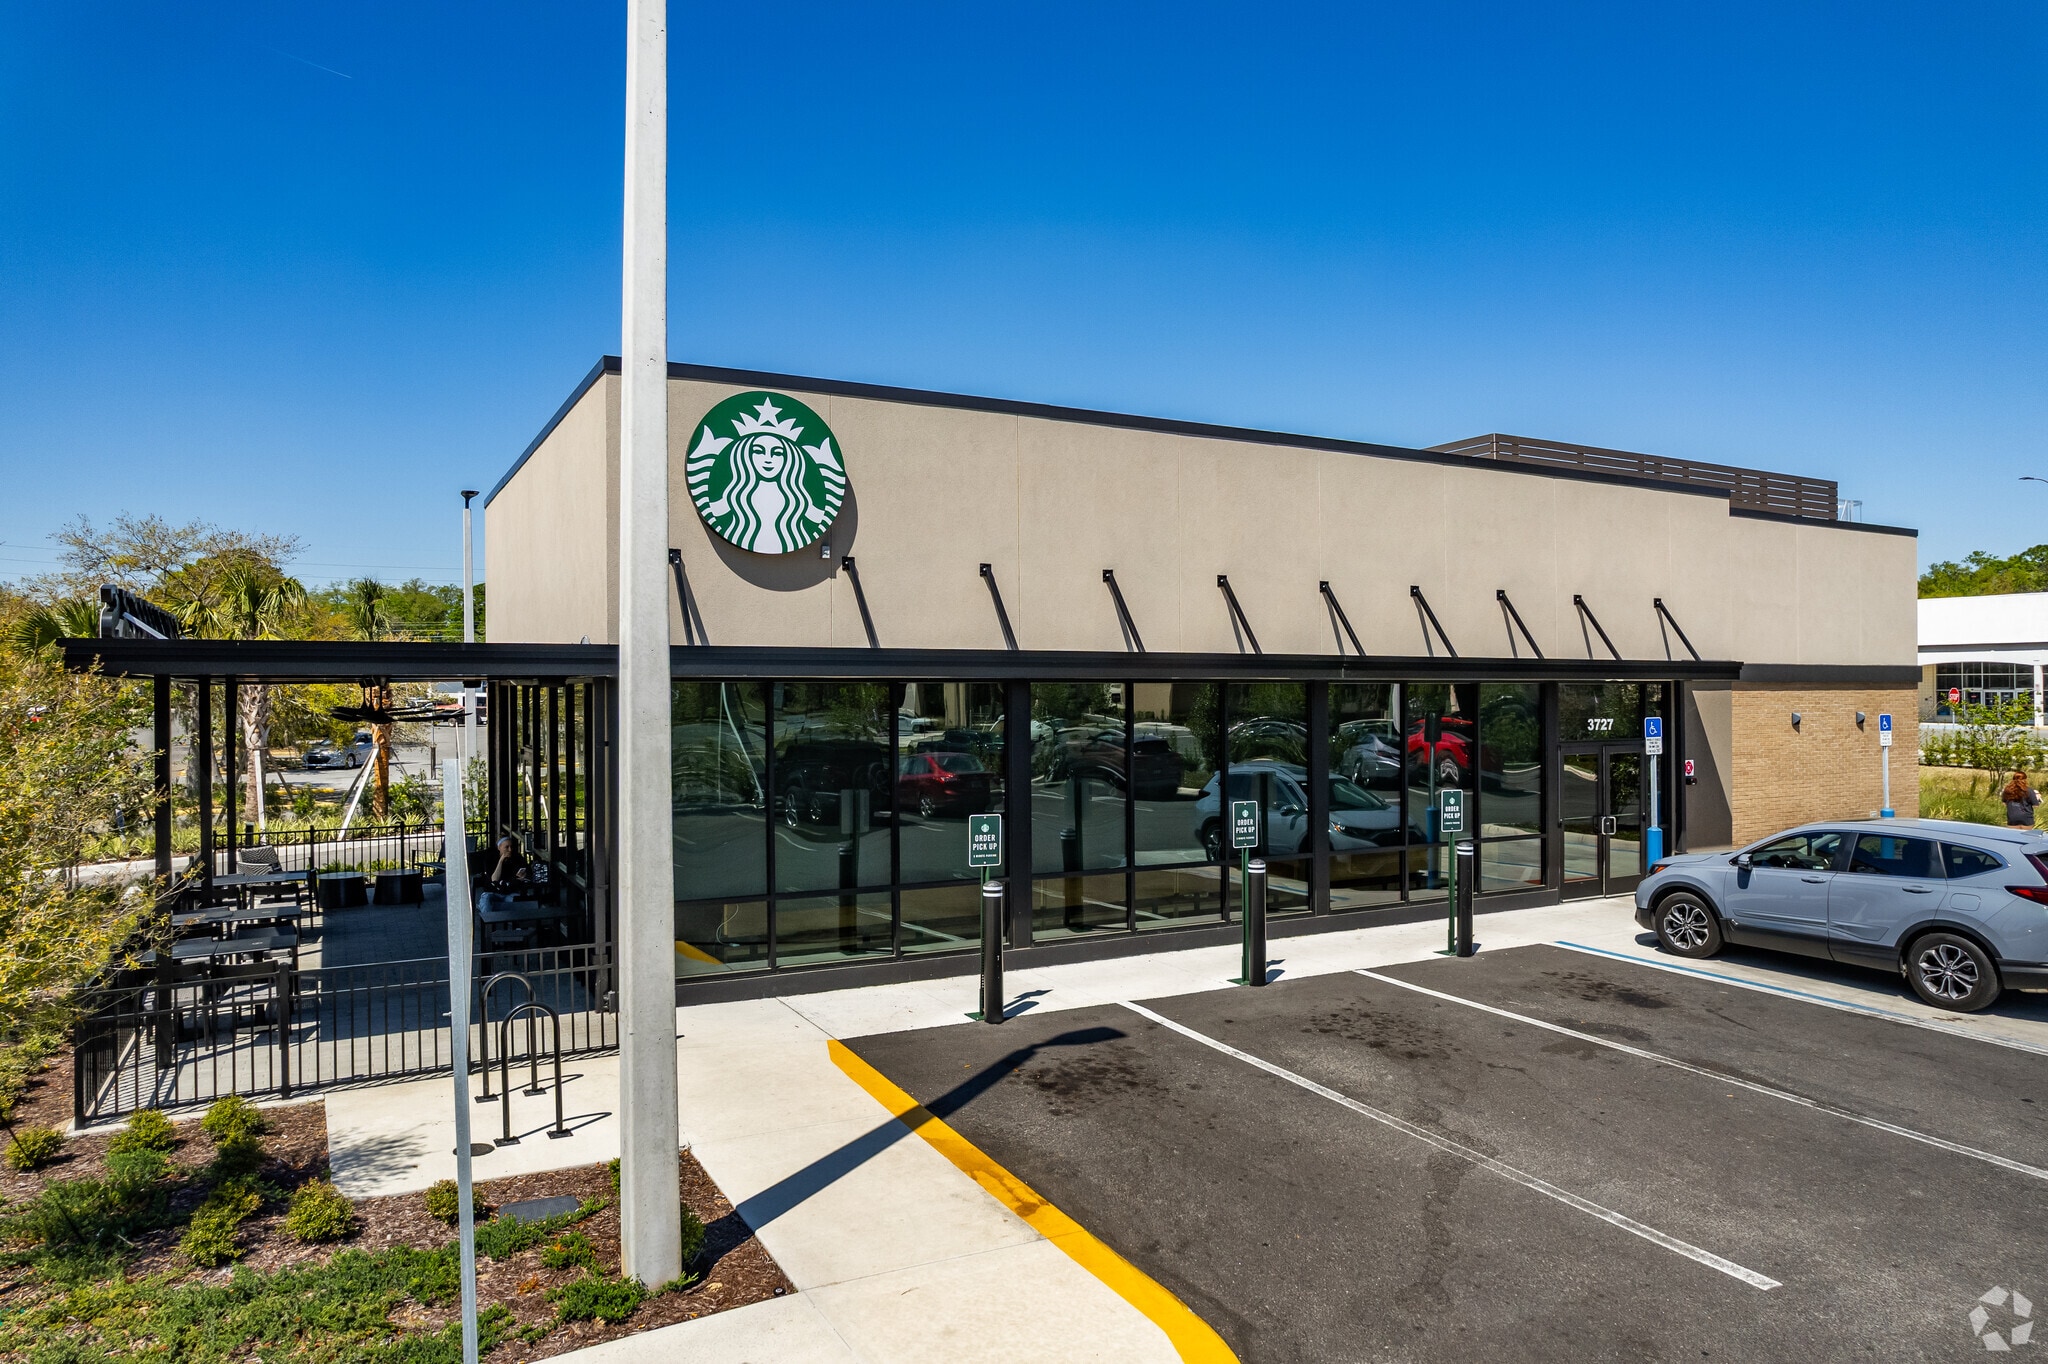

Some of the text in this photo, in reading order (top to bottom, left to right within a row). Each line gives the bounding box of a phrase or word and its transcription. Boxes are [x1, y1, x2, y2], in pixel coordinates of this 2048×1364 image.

[1587, 718, 1614, 730] 3727
[974, 834, 995, 842] ORDER
[972, 842, 997, 851] PICK UP
